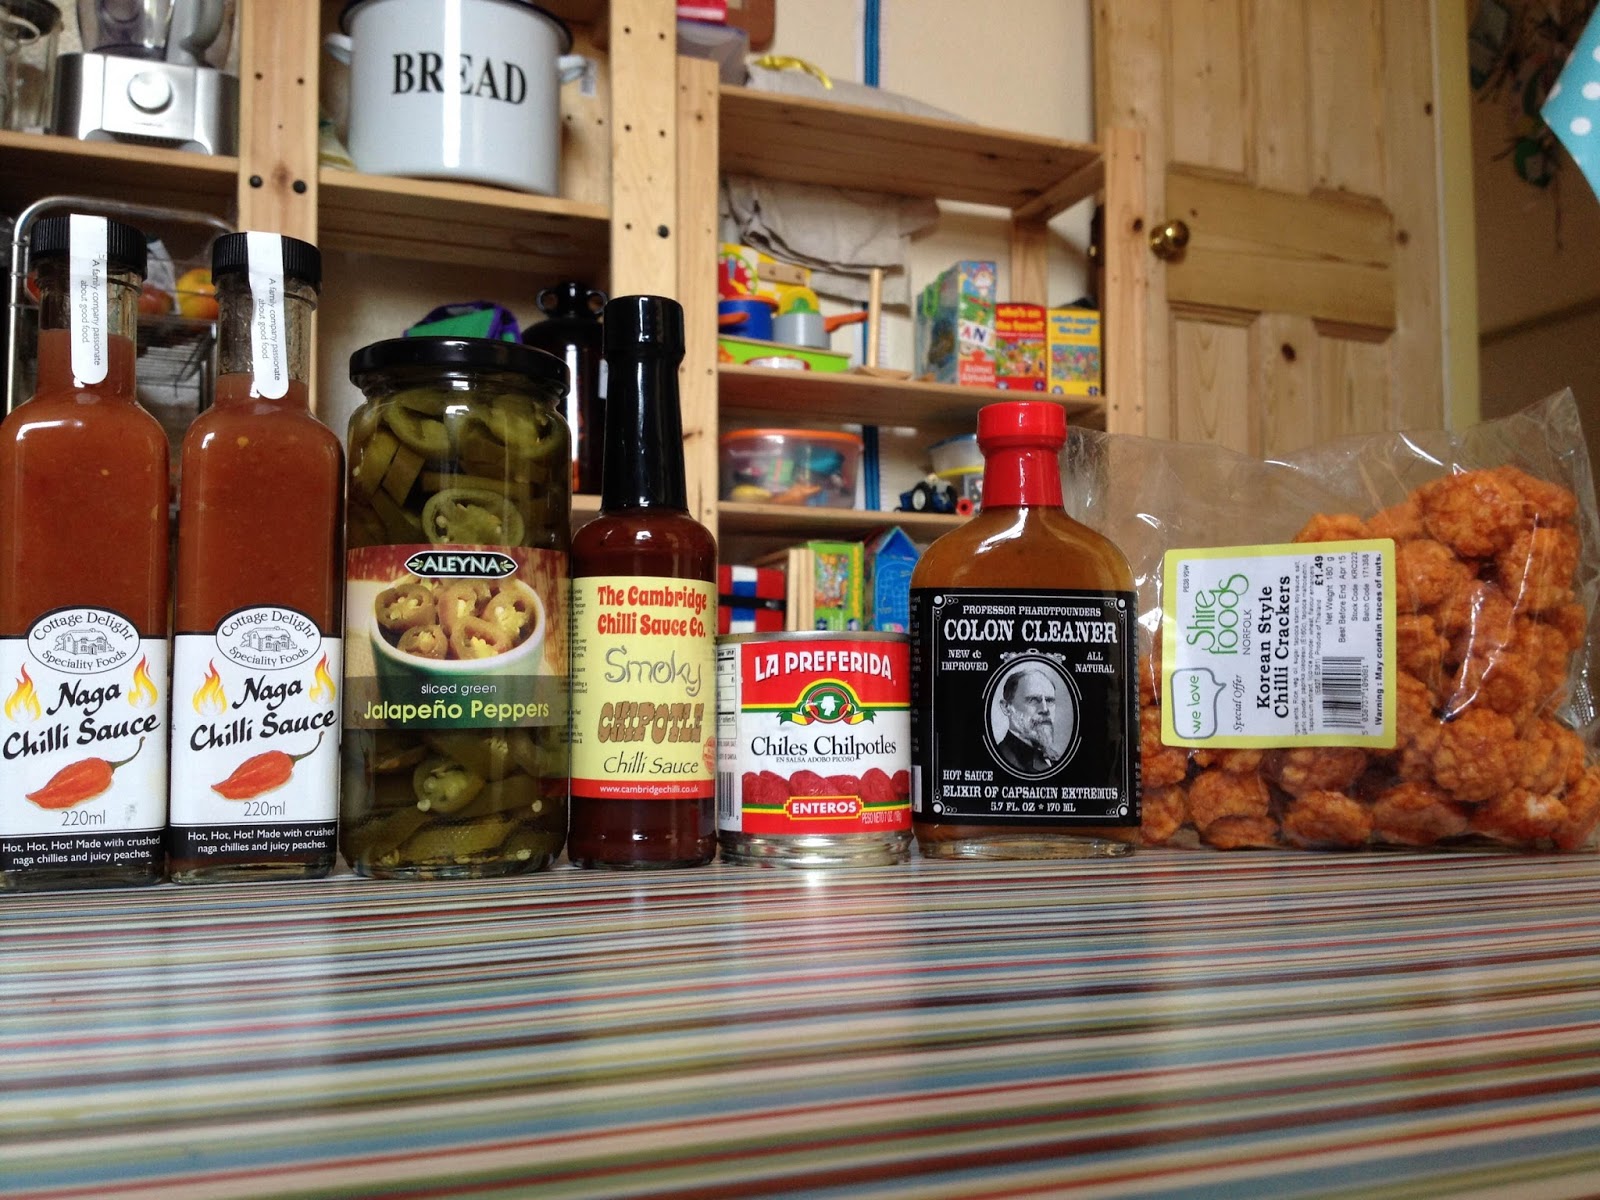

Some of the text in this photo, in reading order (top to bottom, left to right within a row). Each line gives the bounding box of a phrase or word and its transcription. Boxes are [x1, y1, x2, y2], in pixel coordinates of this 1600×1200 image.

[392, 51, 527, 105] BREAD
[91, 269, 100, 290] family
[81, 280, 89, 302] about
[267, 287, 277, 308] family
[79, 304, 89, 323] good
[91, 292, 100, 325] company
[258, 298, 266, 320] about
[257, 321, 268, 340] good
[269, 309, 278, 342] company
[91, 327, 101, 366] passionate
[271, 343, 280, 381] passionate
[422, 556, 501, 573] ALEYNA
[1314, 556, 1323, 586] £1.49
[1339, 556, 1346, 564] 15
[1375, 580, 1382, 588] of
[597, 585, 707, 615] The Cambridge
[1326, 585, 1334, 610] Weight
[962, 606, 1101, 617] PROFESSOR PHARDTPOUNDERS
[1186, 590, 1215, 650] Shire
[1338, 601, 1346, 624] Before
[33, 612, 135, 641] Cottage Delight
[221, 611, 316, 640] Cottage Delight
[597, 612, 706, 638] Chilli Sauce Co.
[944, 619, 1118, 643] COLON CLEANER
[1243, 609, 1252, 655] NORFOLK
[1338, 627, 1346, 643] Best
[229, 646, 309, 666] Speciality Foods
[948, 650, 970, 659] NEW
[1087, 652, 1104, 661] ALL
[1257, 586, 1274, 709] Korean Style
[1275, 576, 1290, 718] Chilli Crackers
[42, 649, 127, 670] Speciality Foods
[754, 651, 893, 682] LA PREFERIDA
[942, 661, 989, 671] IMPROVED
[1075, 663, 1115, 673] NATURAL
[1375, 661, 1384, 680] May
[604, 645, 701, 697] Smoky
[46, 679, 121, 716] Naga
[232, 675, 303, 711] Naga
[421, 683, 497, 696] sliced green
[364, 699, 549, 723] Jalapeño Peppers
[1186, 675, 1201, 734] we love
[1232, 675, 1244, 732] Special Offer
[1375, 689, 1383, 726] Warning
[190, 709, 337, 752] Chilli Sauce
[598, 701, 704, 744] CHIPOTLE
[3, 714, 160, 760] Chilli Sauce
[751, 736, 808, 756] Chiles
[814, 734, 896, 760] Chilpotles
[604, 751, 699, 774] Chilli Sauce
[943, 770, 994, 781] HOT SAUCE
[600, 785, 699, 795] www.cambridgechilli.co.uk
[943, 785, 1118, 799] ELIXIR OF CAPSAICIN EXTREMUS
[61, 809, 106, 827] 220ml
[243, 801, 285, 817] 220ml
[792, 802, 857, 814] ENTEROS
[990, 802, 1076, 812] 5.7 FL. OZ 170 ML
[2, 835, 161, 854] Hot, Hot, Hot! Made with crushed
[188, 826, 335, 841] Hot, Hot, Hot! Made with crushed
[13, 849, 152, 866] naga chillies and juicy peaches.
[197, 840, 327, 855] naga chillies and juicy peaches.
